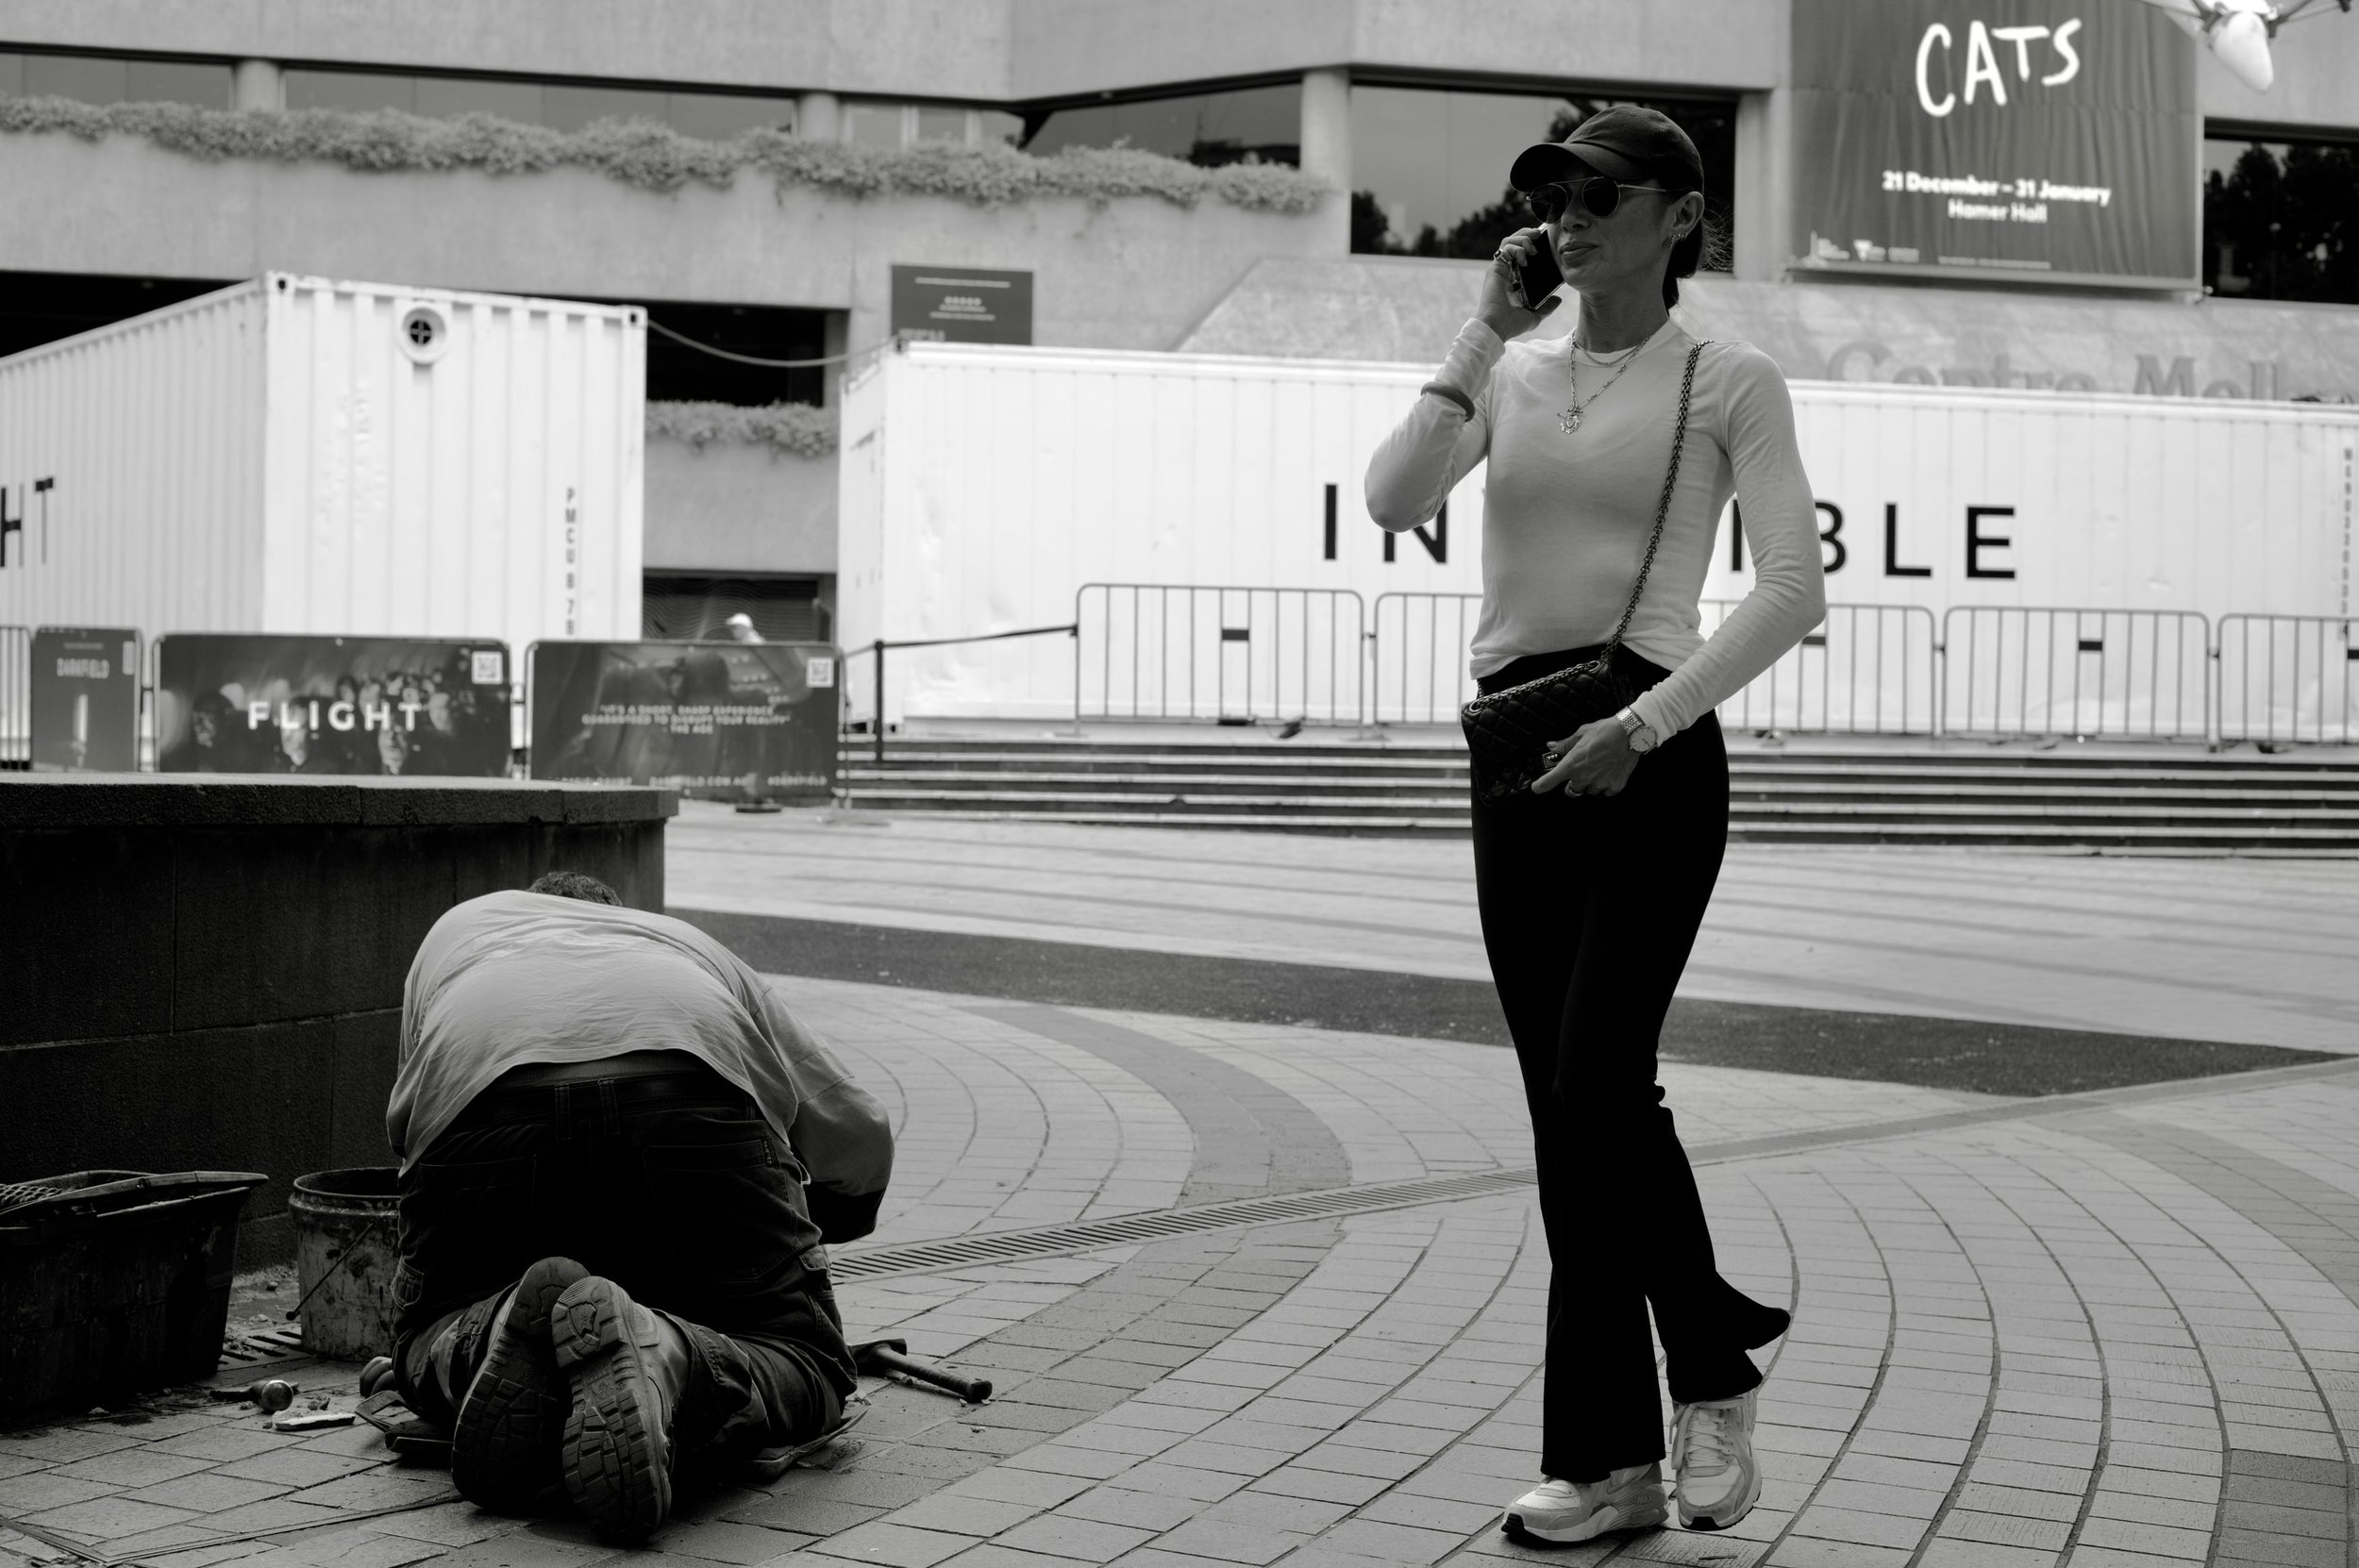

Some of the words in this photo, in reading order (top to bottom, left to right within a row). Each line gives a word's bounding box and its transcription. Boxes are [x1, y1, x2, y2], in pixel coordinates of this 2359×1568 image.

[1916, 18, 2082, 117] CATS
[1882, 170, 1904, 192] 21
[1905, 171, 1999, 196] December
[2038, 179, 2112, 208] January
[2010, 202, 2048, 224] Hall
[248, 700, 422, 732] FLIGHT
